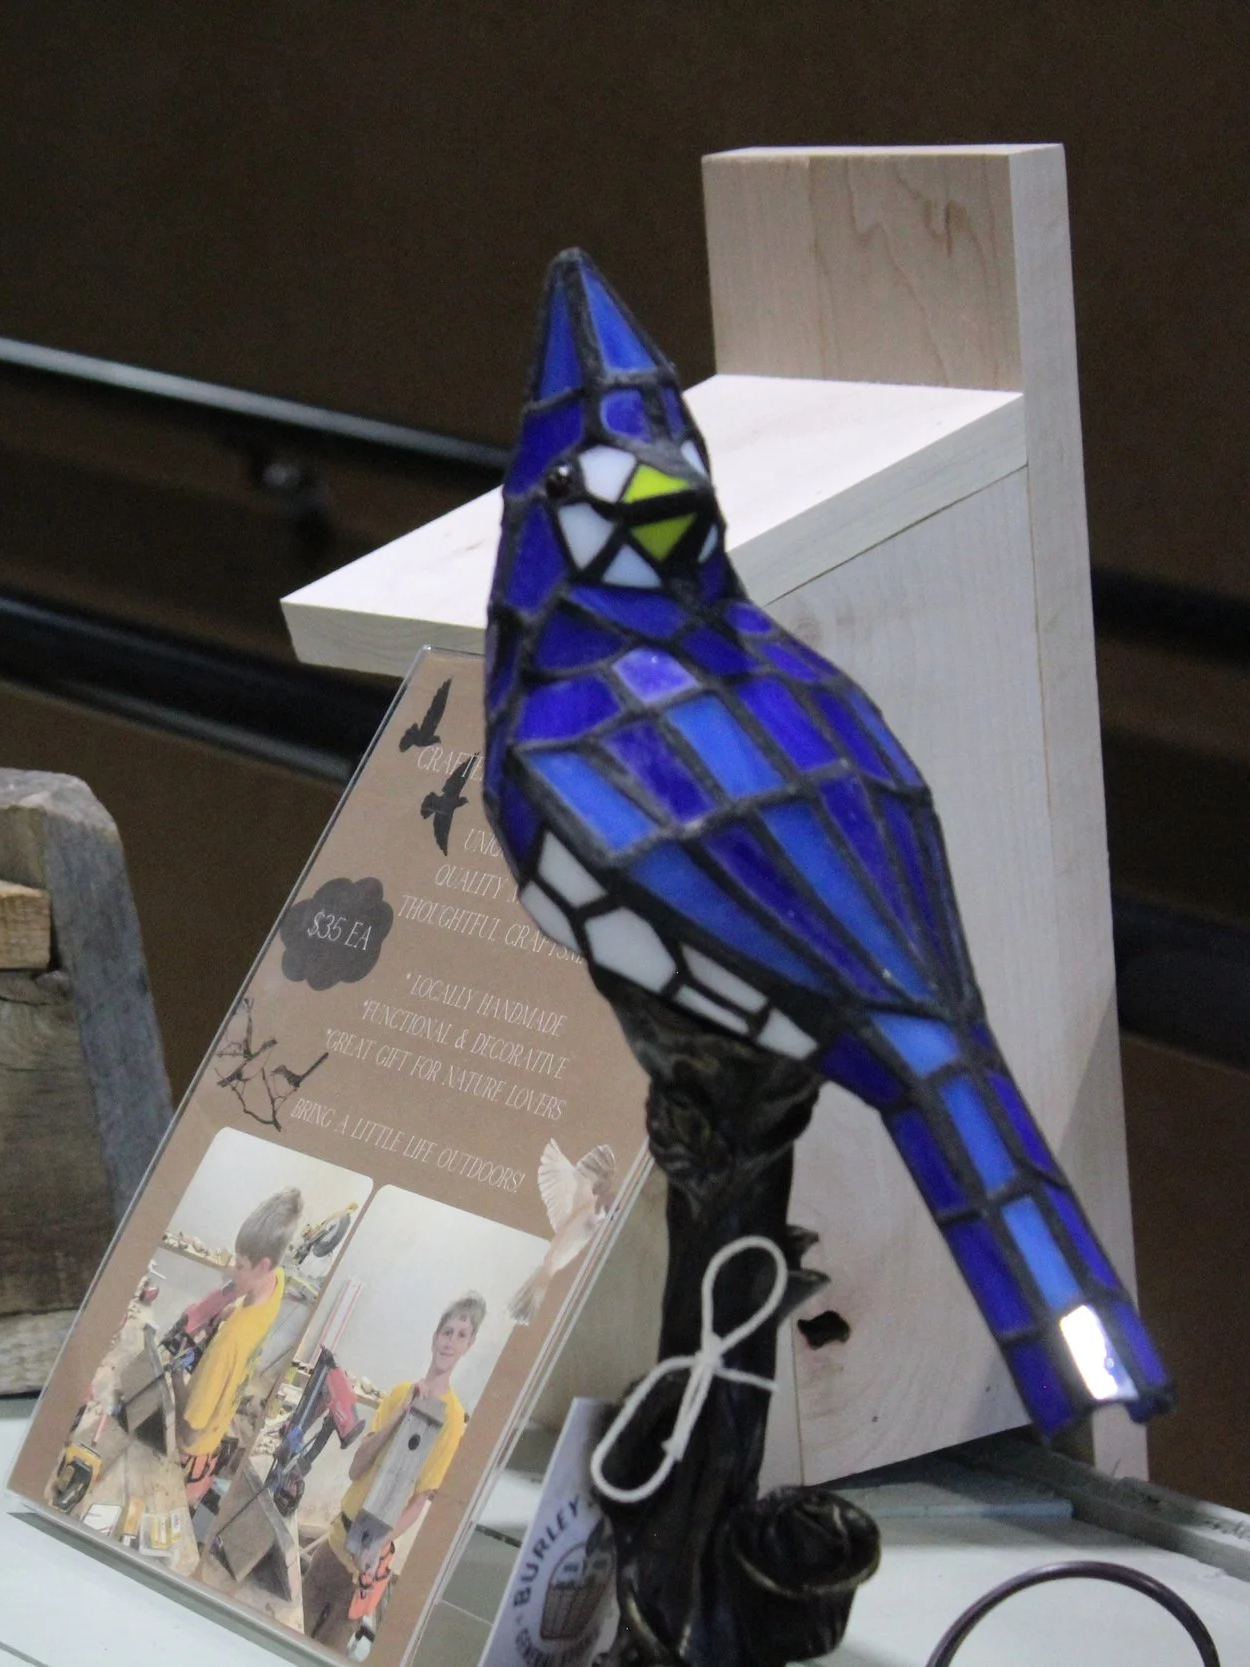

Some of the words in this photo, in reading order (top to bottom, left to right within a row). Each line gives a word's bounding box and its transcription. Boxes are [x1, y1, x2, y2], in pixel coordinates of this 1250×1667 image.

[435, 863, 509, 900] QUALITY
[307, 908, 347, 942] $35
[344, 921, 372, 951] EA
[397, 895, 501, 942] THOUGHTFUL
[476, 993, 568, 1037] HANDMADE
[454, 1028, 470, 1050] &
[470, 1032, 570, 1080] DECORATIVE
[375, 1044, 412, 1073] GIFT
[410, 1055, 442, 1081] FOR
[441, 1065, 507, 1101] NATURE
[504, 1084, 567, 1121] LOVERS
[290, 1097, 336, 1129] BRING
[333, 1114, 349, 1135] A
[350, 1117, 406, 1153] LITTLE
[403, 1135, 439, 1163] LIFE
[437, 1147, 526, 1193] OUTDOORS!
[513, 1494, 580, 1608] BURLEY
